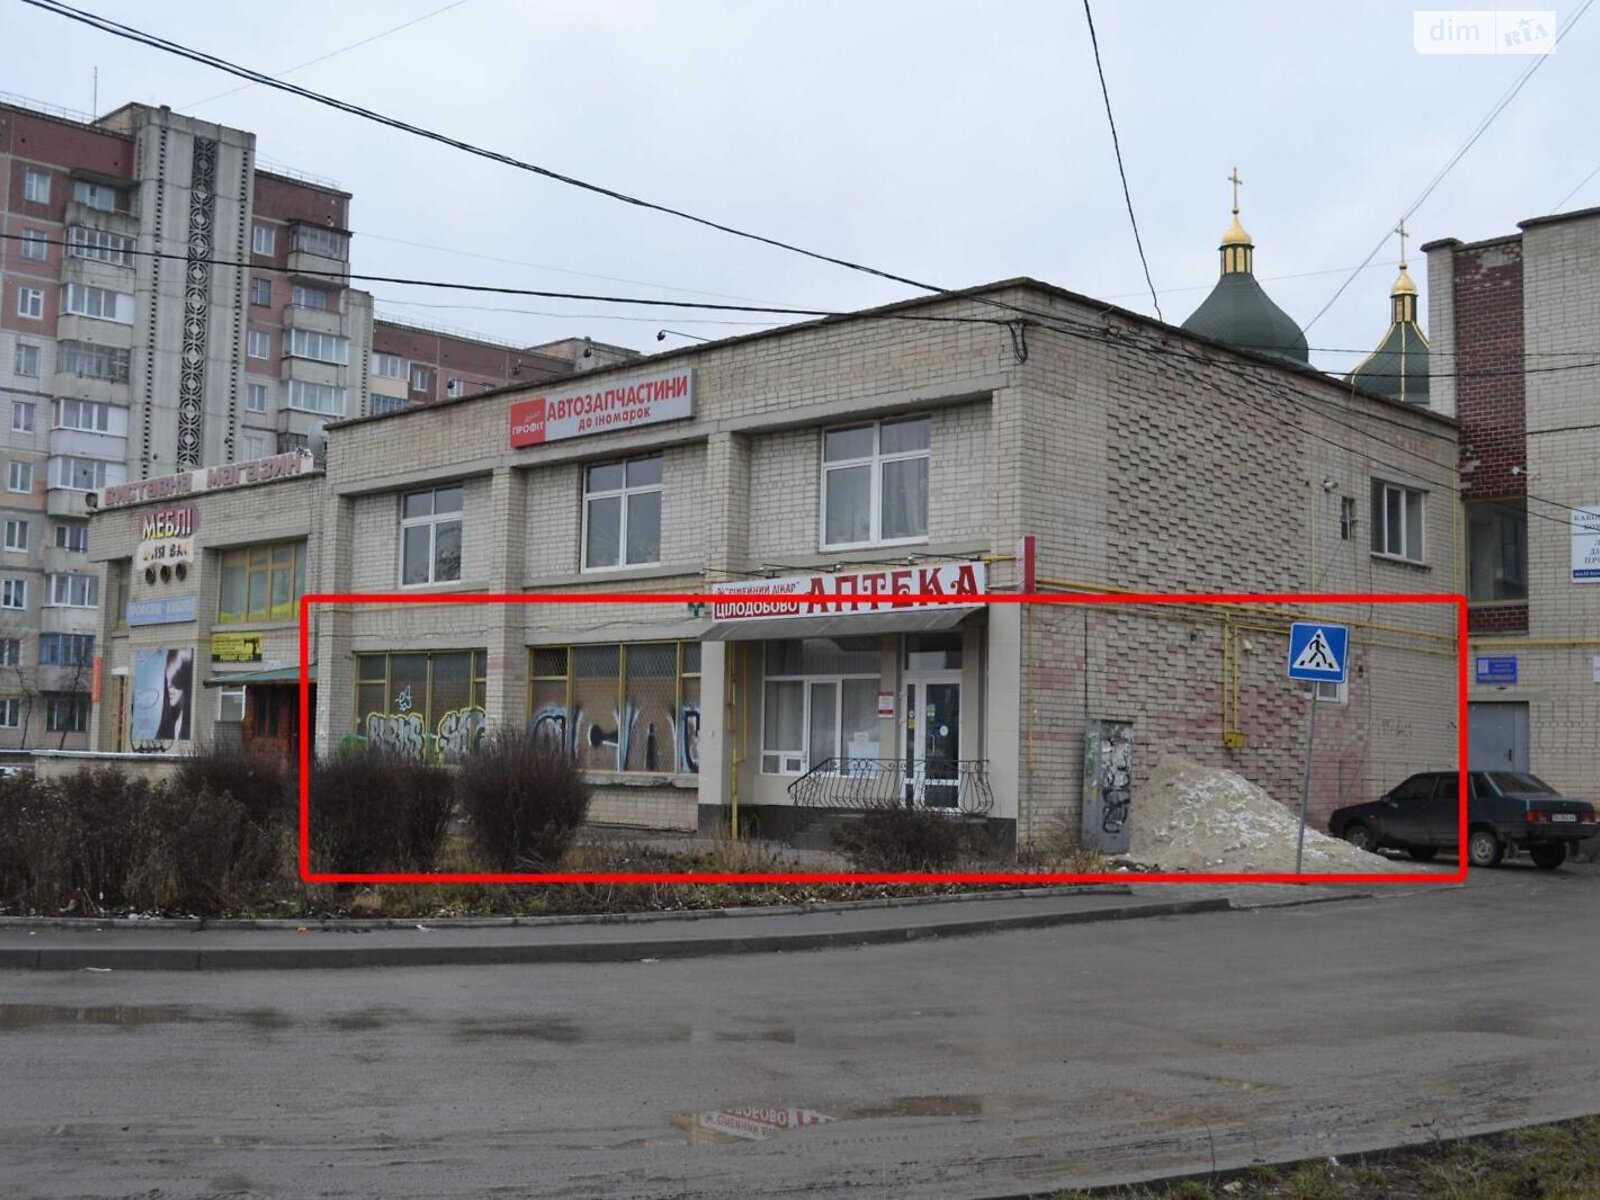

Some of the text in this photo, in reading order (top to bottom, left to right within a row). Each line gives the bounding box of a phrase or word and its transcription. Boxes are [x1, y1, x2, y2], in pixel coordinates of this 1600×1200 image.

[546, 376, 688, 422] АВТОЗАПЧАСТИНИ
[143, 508, 193, 540] МЕБЛІ
[716, 595, 798, 613] ЦІЛОДОБОВО
[805, 565, 979, 614] АПТЕКА
